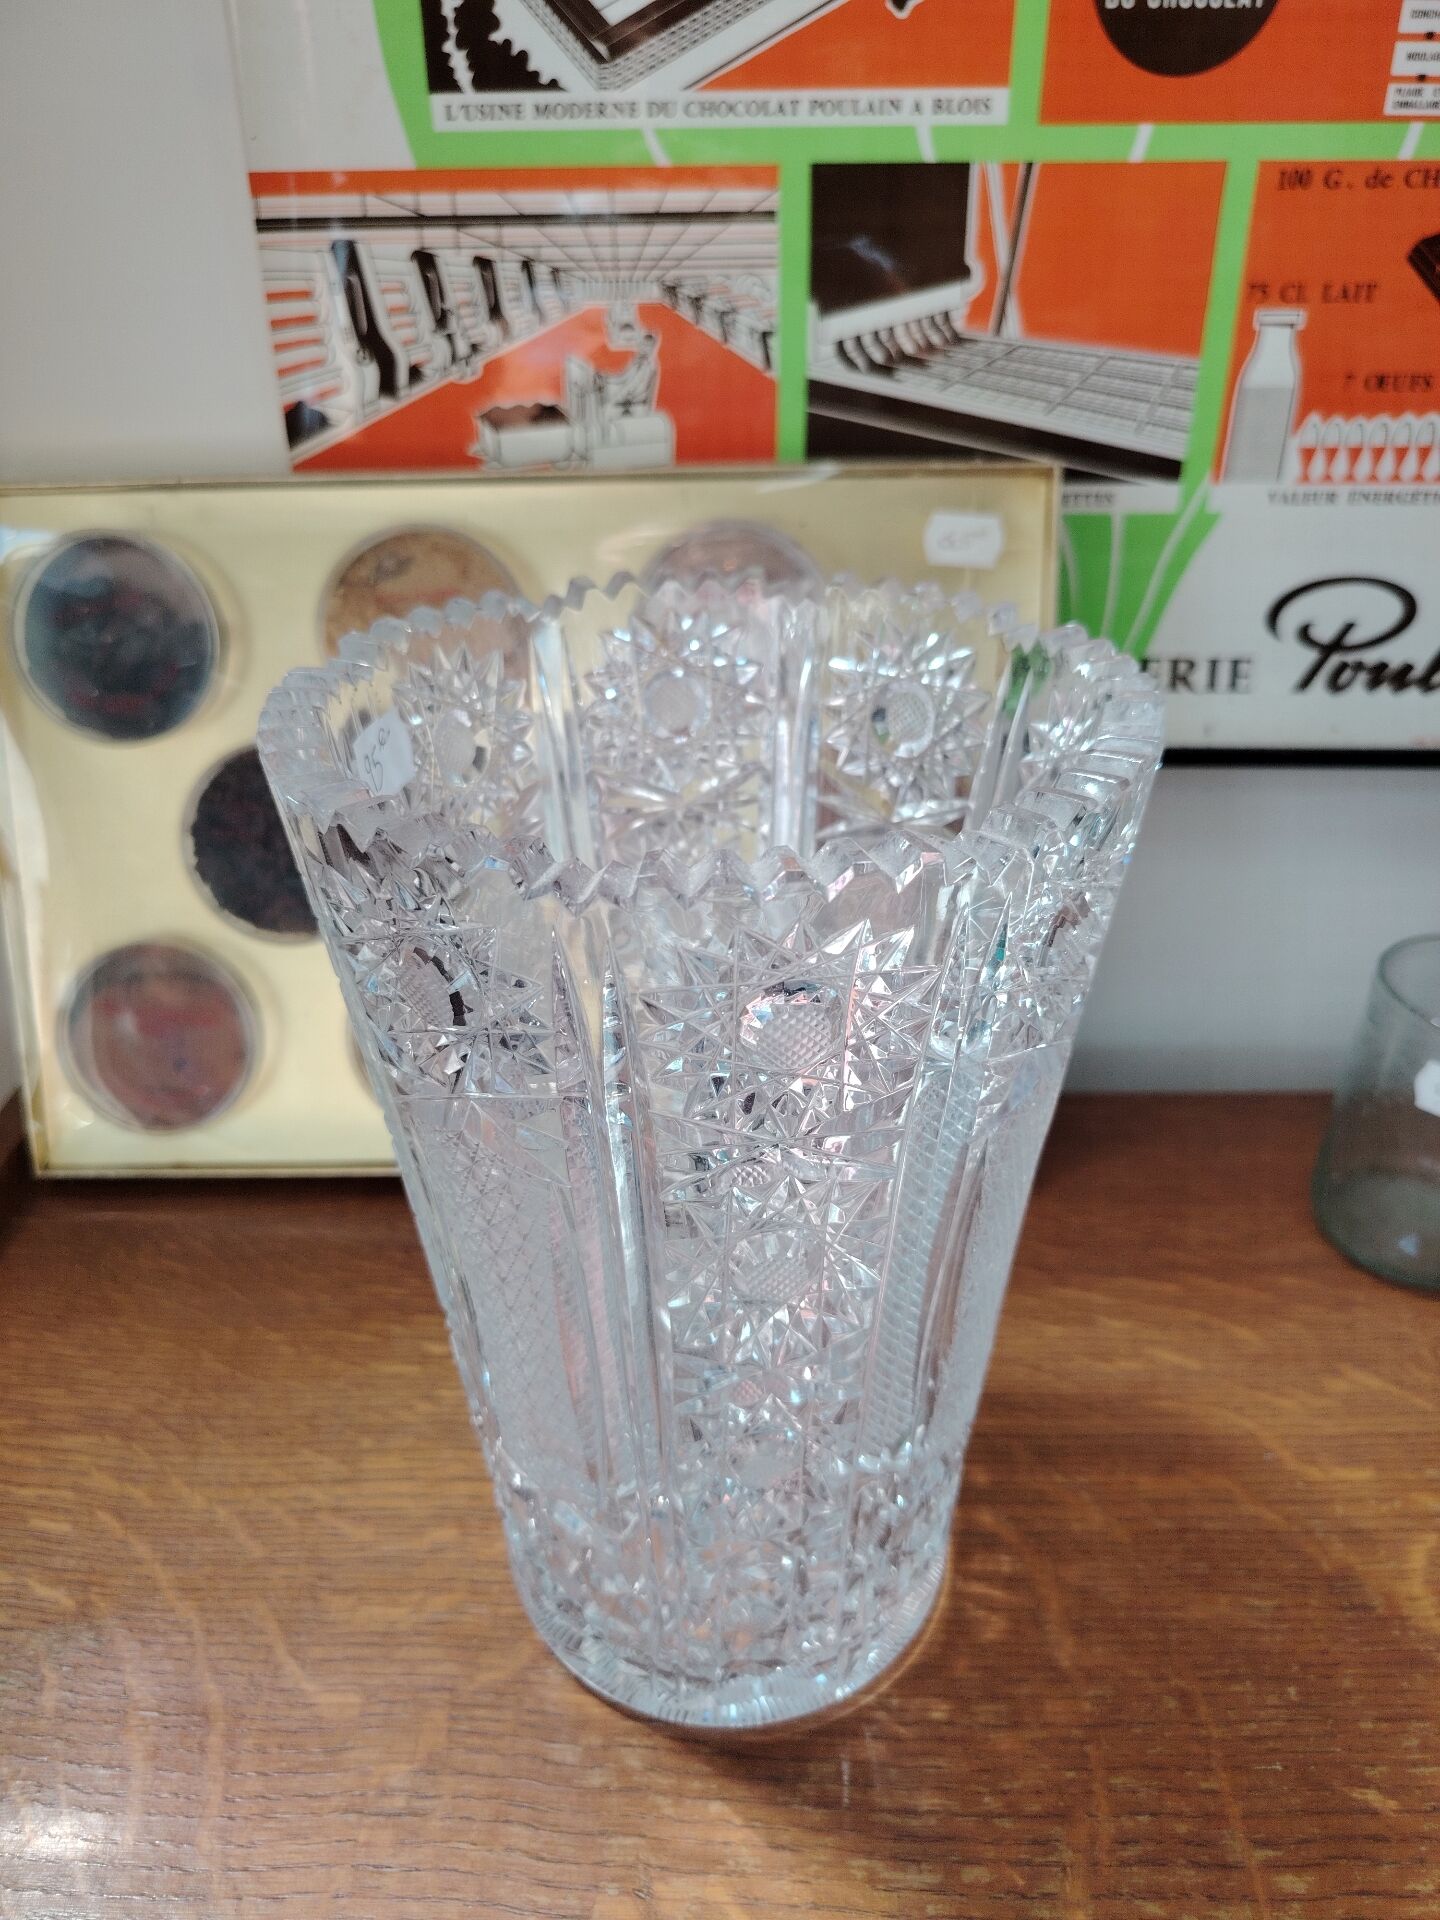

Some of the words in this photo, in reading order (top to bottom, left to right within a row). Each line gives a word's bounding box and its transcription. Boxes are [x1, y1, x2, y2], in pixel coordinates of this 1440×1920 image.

[444, 103, 525, 122] L'USINE
[532, 101, 638, 121] MODERNE
[649, 101, 678, 119] DU
[682, 99, 800, 118] CHOCOLAT
[808, 98, 901, 117] POULAIN
[931, 97, 993, 116] BLOIS
[1278, 167, 1314, 191] 100
[1364, 166, 1394, 190] de
[1320, 280, 1378, 303] LAIT
